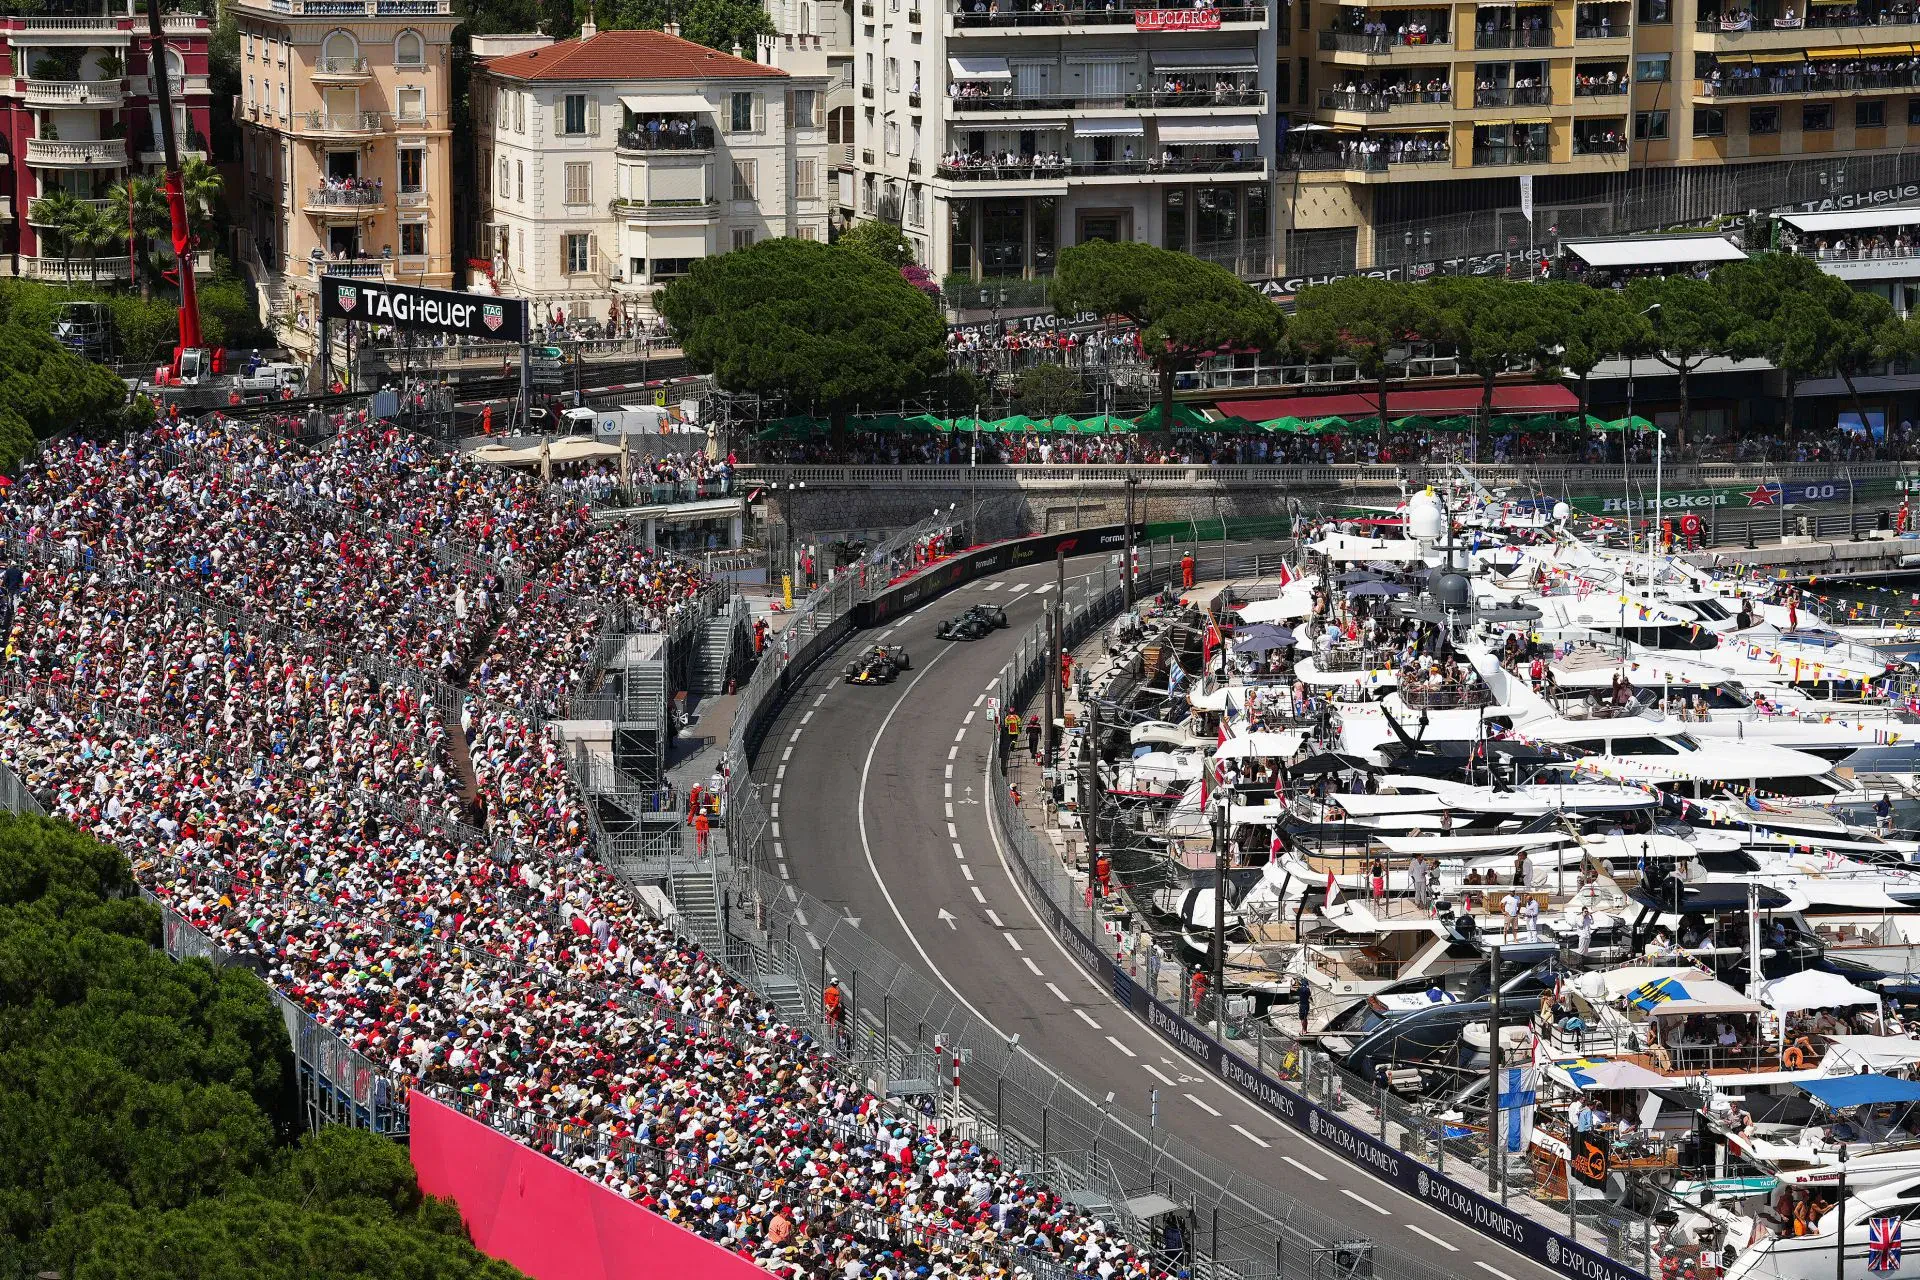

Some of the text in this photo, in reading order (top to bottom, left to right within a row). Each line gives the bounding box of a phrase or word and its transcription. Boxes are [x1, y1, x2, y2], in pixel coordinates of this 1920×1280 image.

[1149, 11, 1208, 25] LECLERC
[340, 287, 355, 297] TAG
[485, 305, 501, 316] TAG
[1169, 425, 1198, 433] eineken
[1804, 485, 1835, 499] 0.0
[1601, 493, 1728, 512] Heineken
[1155, 1013, 1210, 1060] EXPLORA JOURNEYS
[1229, 1062, 1294, 1117] EXPLORA JOURNEYS
[1320, 1117, 1399, 1177] EXPLORA JOURNEYS
[1431, 1179, 1524, 1244] EXPLORA JOURNEYS
